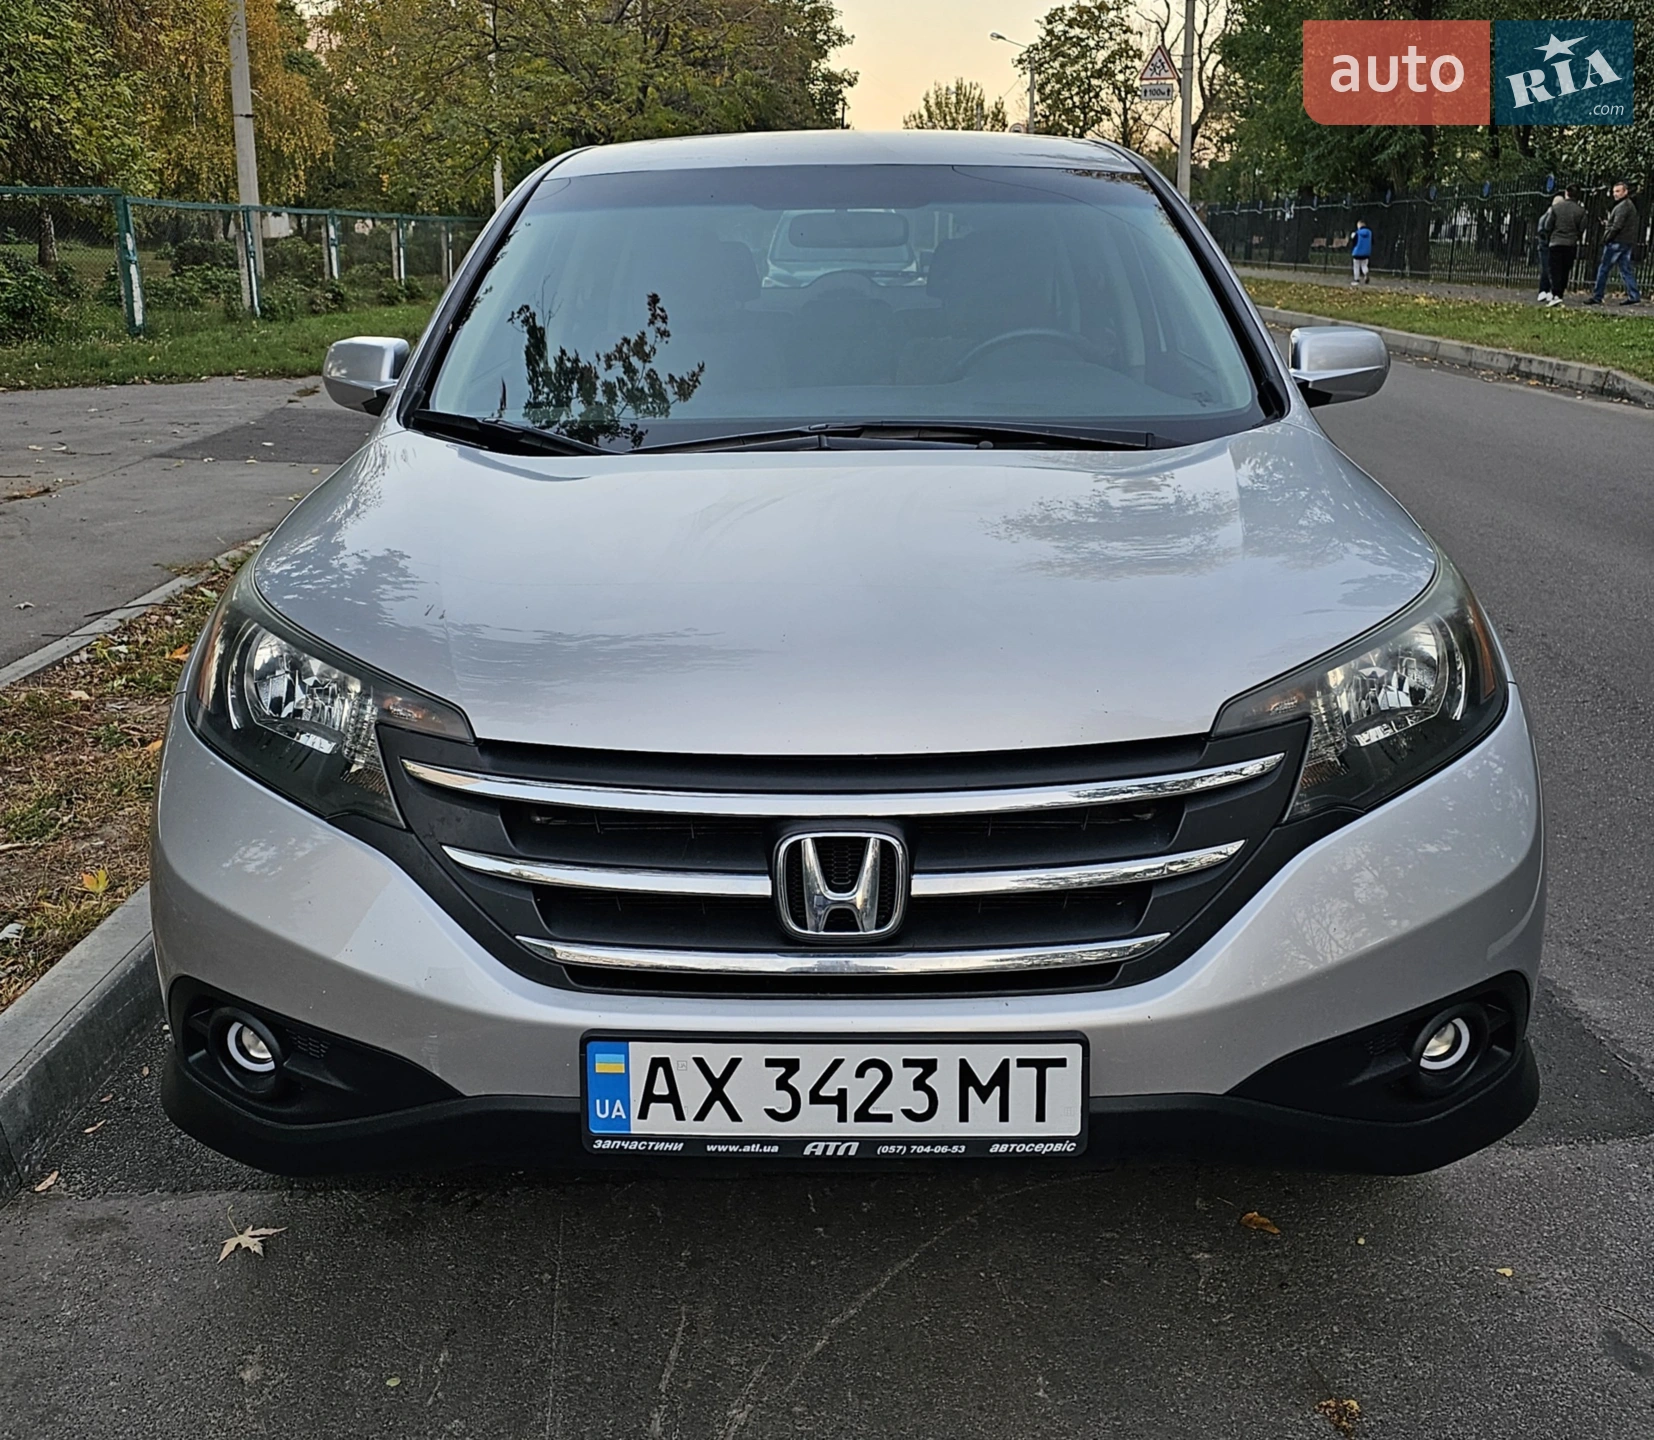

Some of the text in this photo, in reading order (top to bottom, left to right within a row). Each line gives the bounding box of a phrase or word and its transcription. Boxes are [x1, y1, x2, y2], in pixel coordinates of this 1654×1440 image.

[637, 1056, 1068, 1123] AX 3423 MT
[595, 1099, 627, 1120] UA
[593, 1139, 684, 1152] запчастини
[706, 1143, 779, 1153] www.atl.ua
[876, 1145, 966, 1155] (057) 704-06-53
[989, 1140, 1077, 1154] автосервіс
